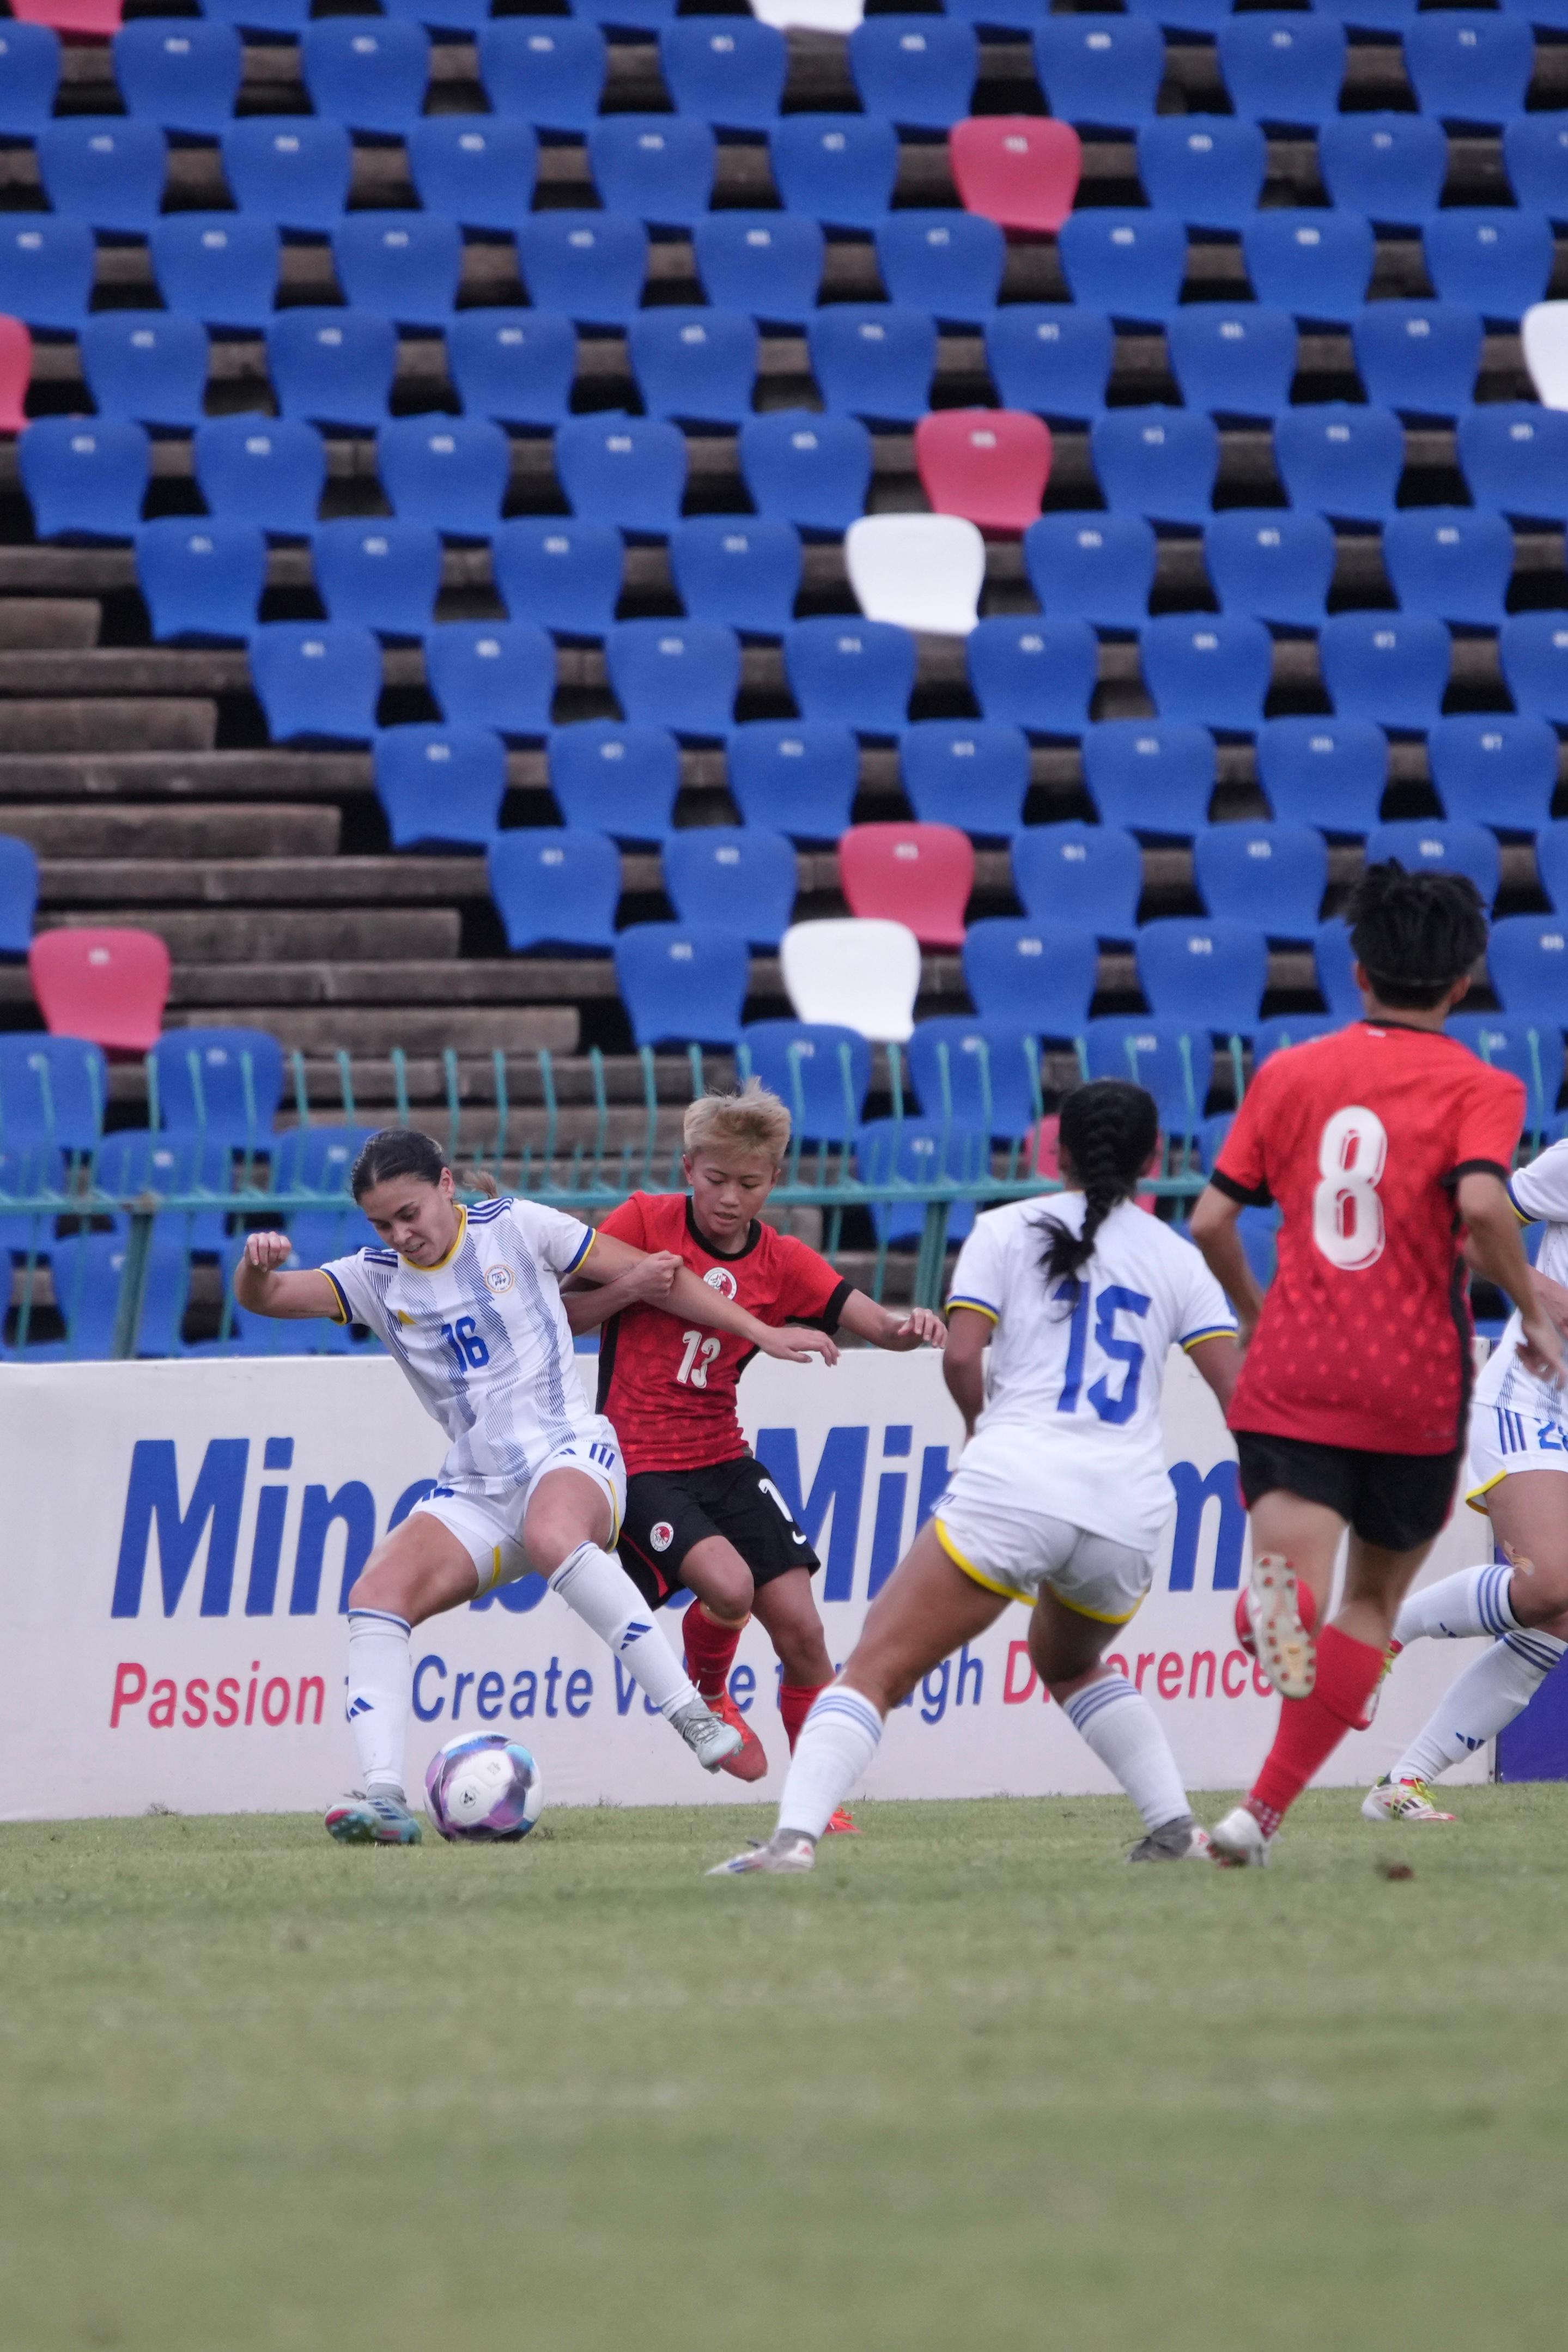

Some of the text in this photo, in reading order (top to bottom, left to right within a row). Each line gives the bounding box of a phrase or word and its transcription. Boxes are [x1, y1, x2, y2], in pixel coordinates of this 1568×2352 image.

[1312, 1105, 1388, 1271] 8
[440, 1315, 490, 1373] 16
[676, 1329, 721, 1389] 13
[1052, 1280, 1152, 1426] 15
[110, 1660, 325, 1729] Passion
[412, 1654, 594, 1723] Create
